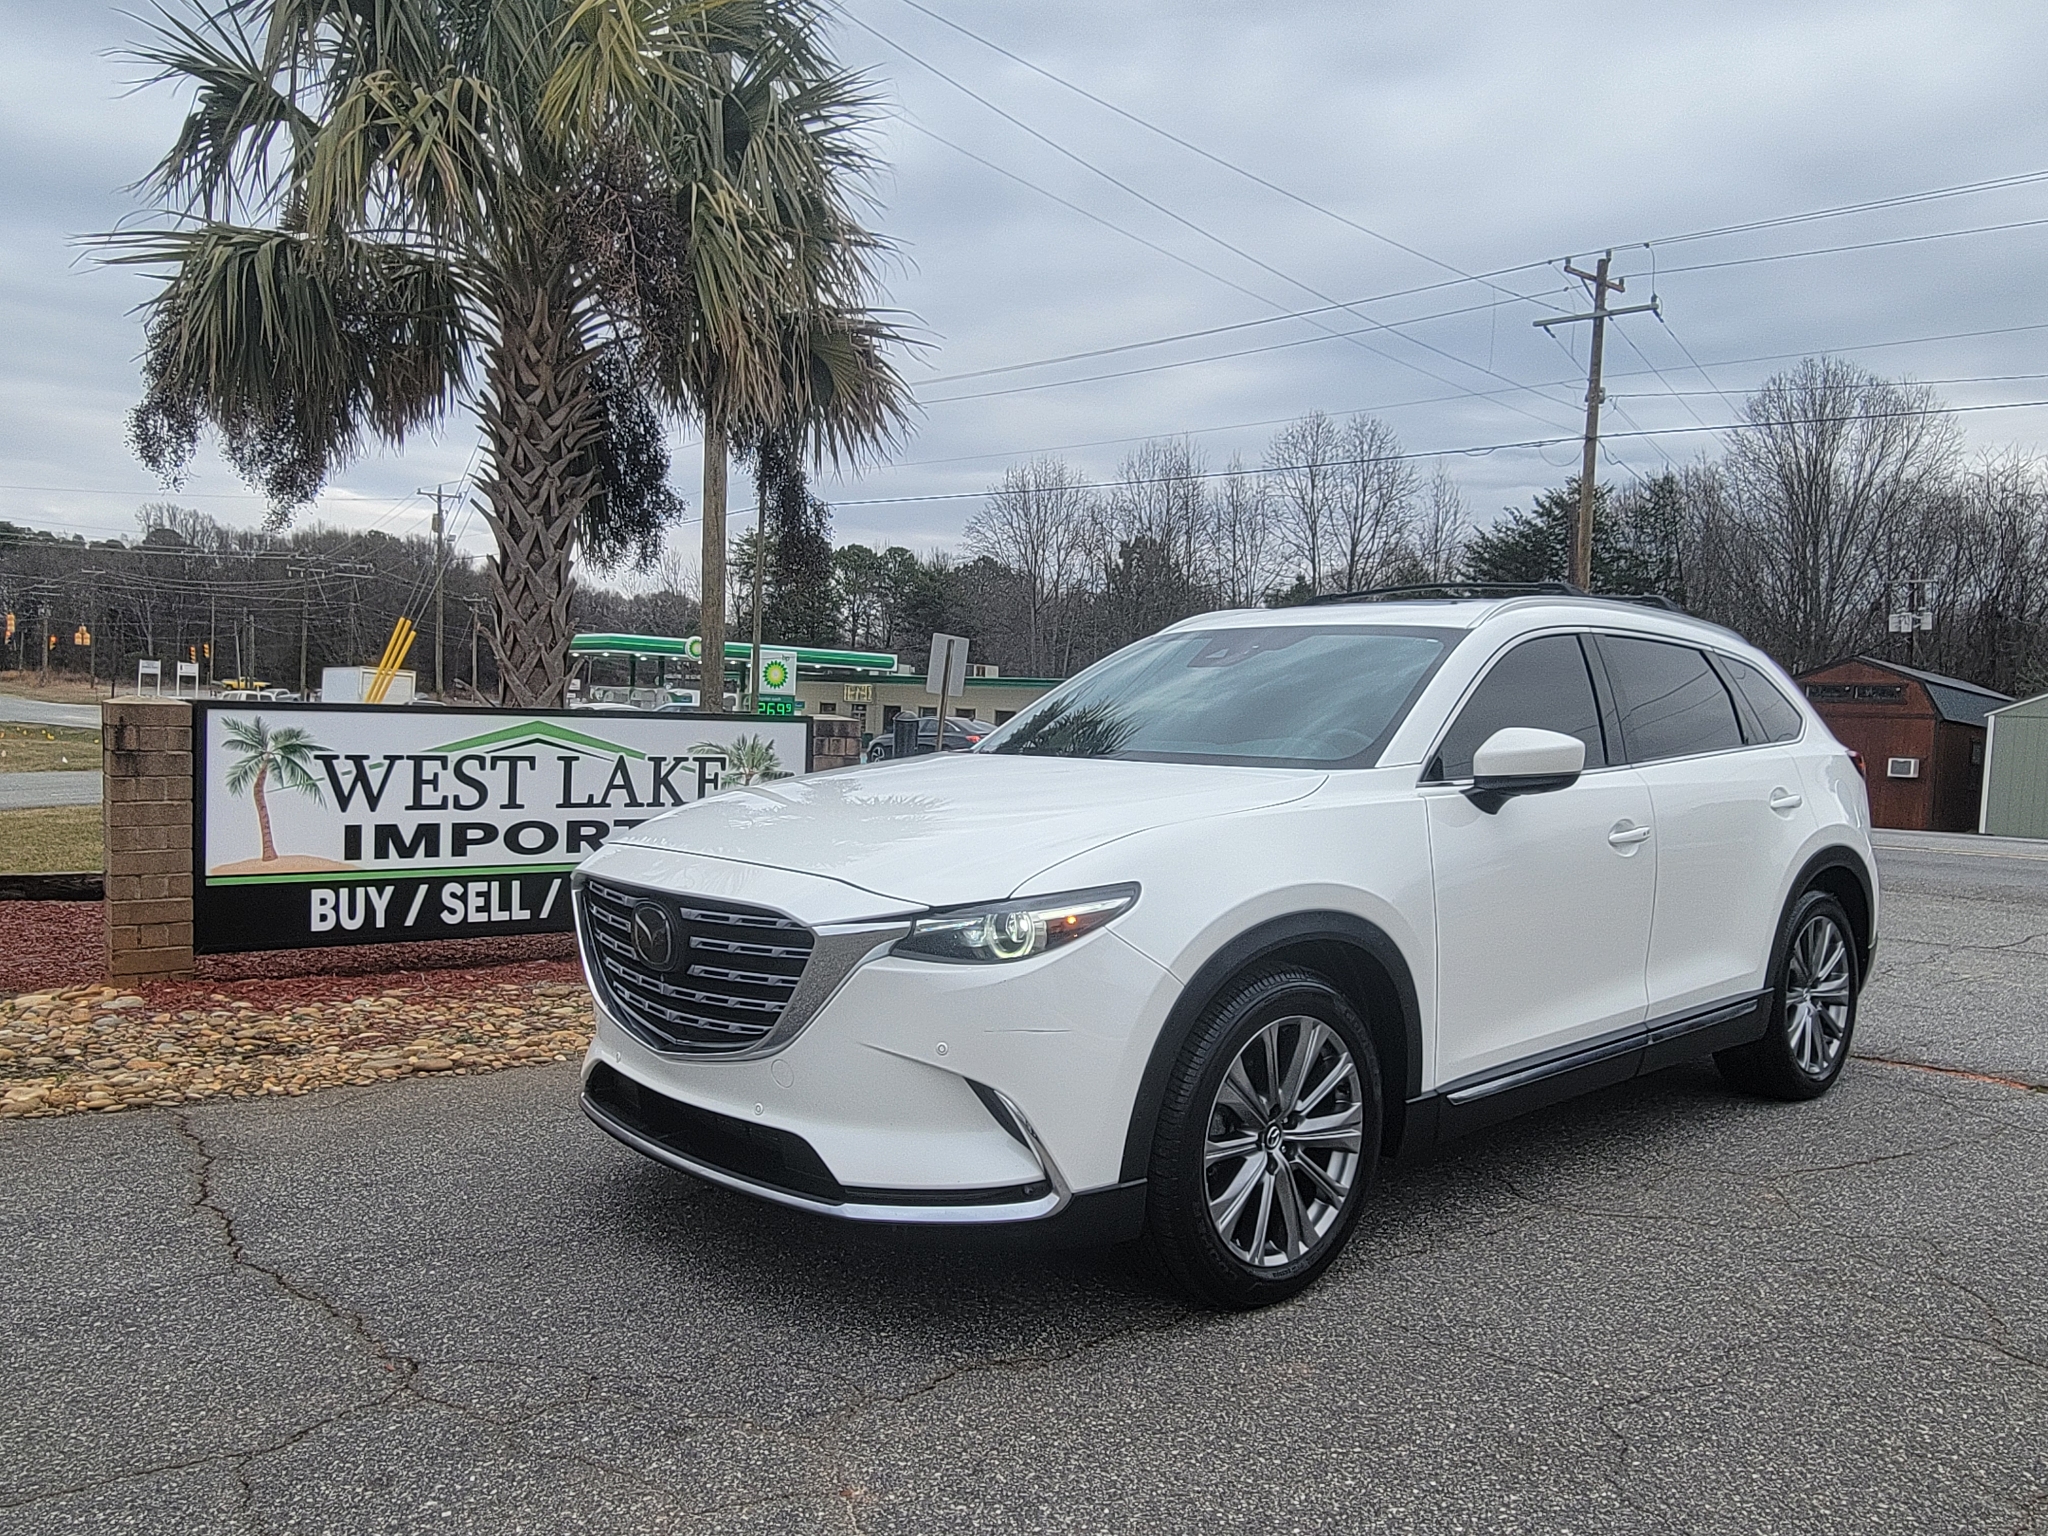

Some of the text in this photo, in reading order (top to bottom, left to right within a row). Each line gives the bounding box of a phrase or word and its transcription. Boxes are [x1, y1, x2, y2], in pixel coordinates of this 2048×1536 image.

[313, 754, 727, 813] WEST LAKE
[310, 878, 562, 932] BUY / SELL /
